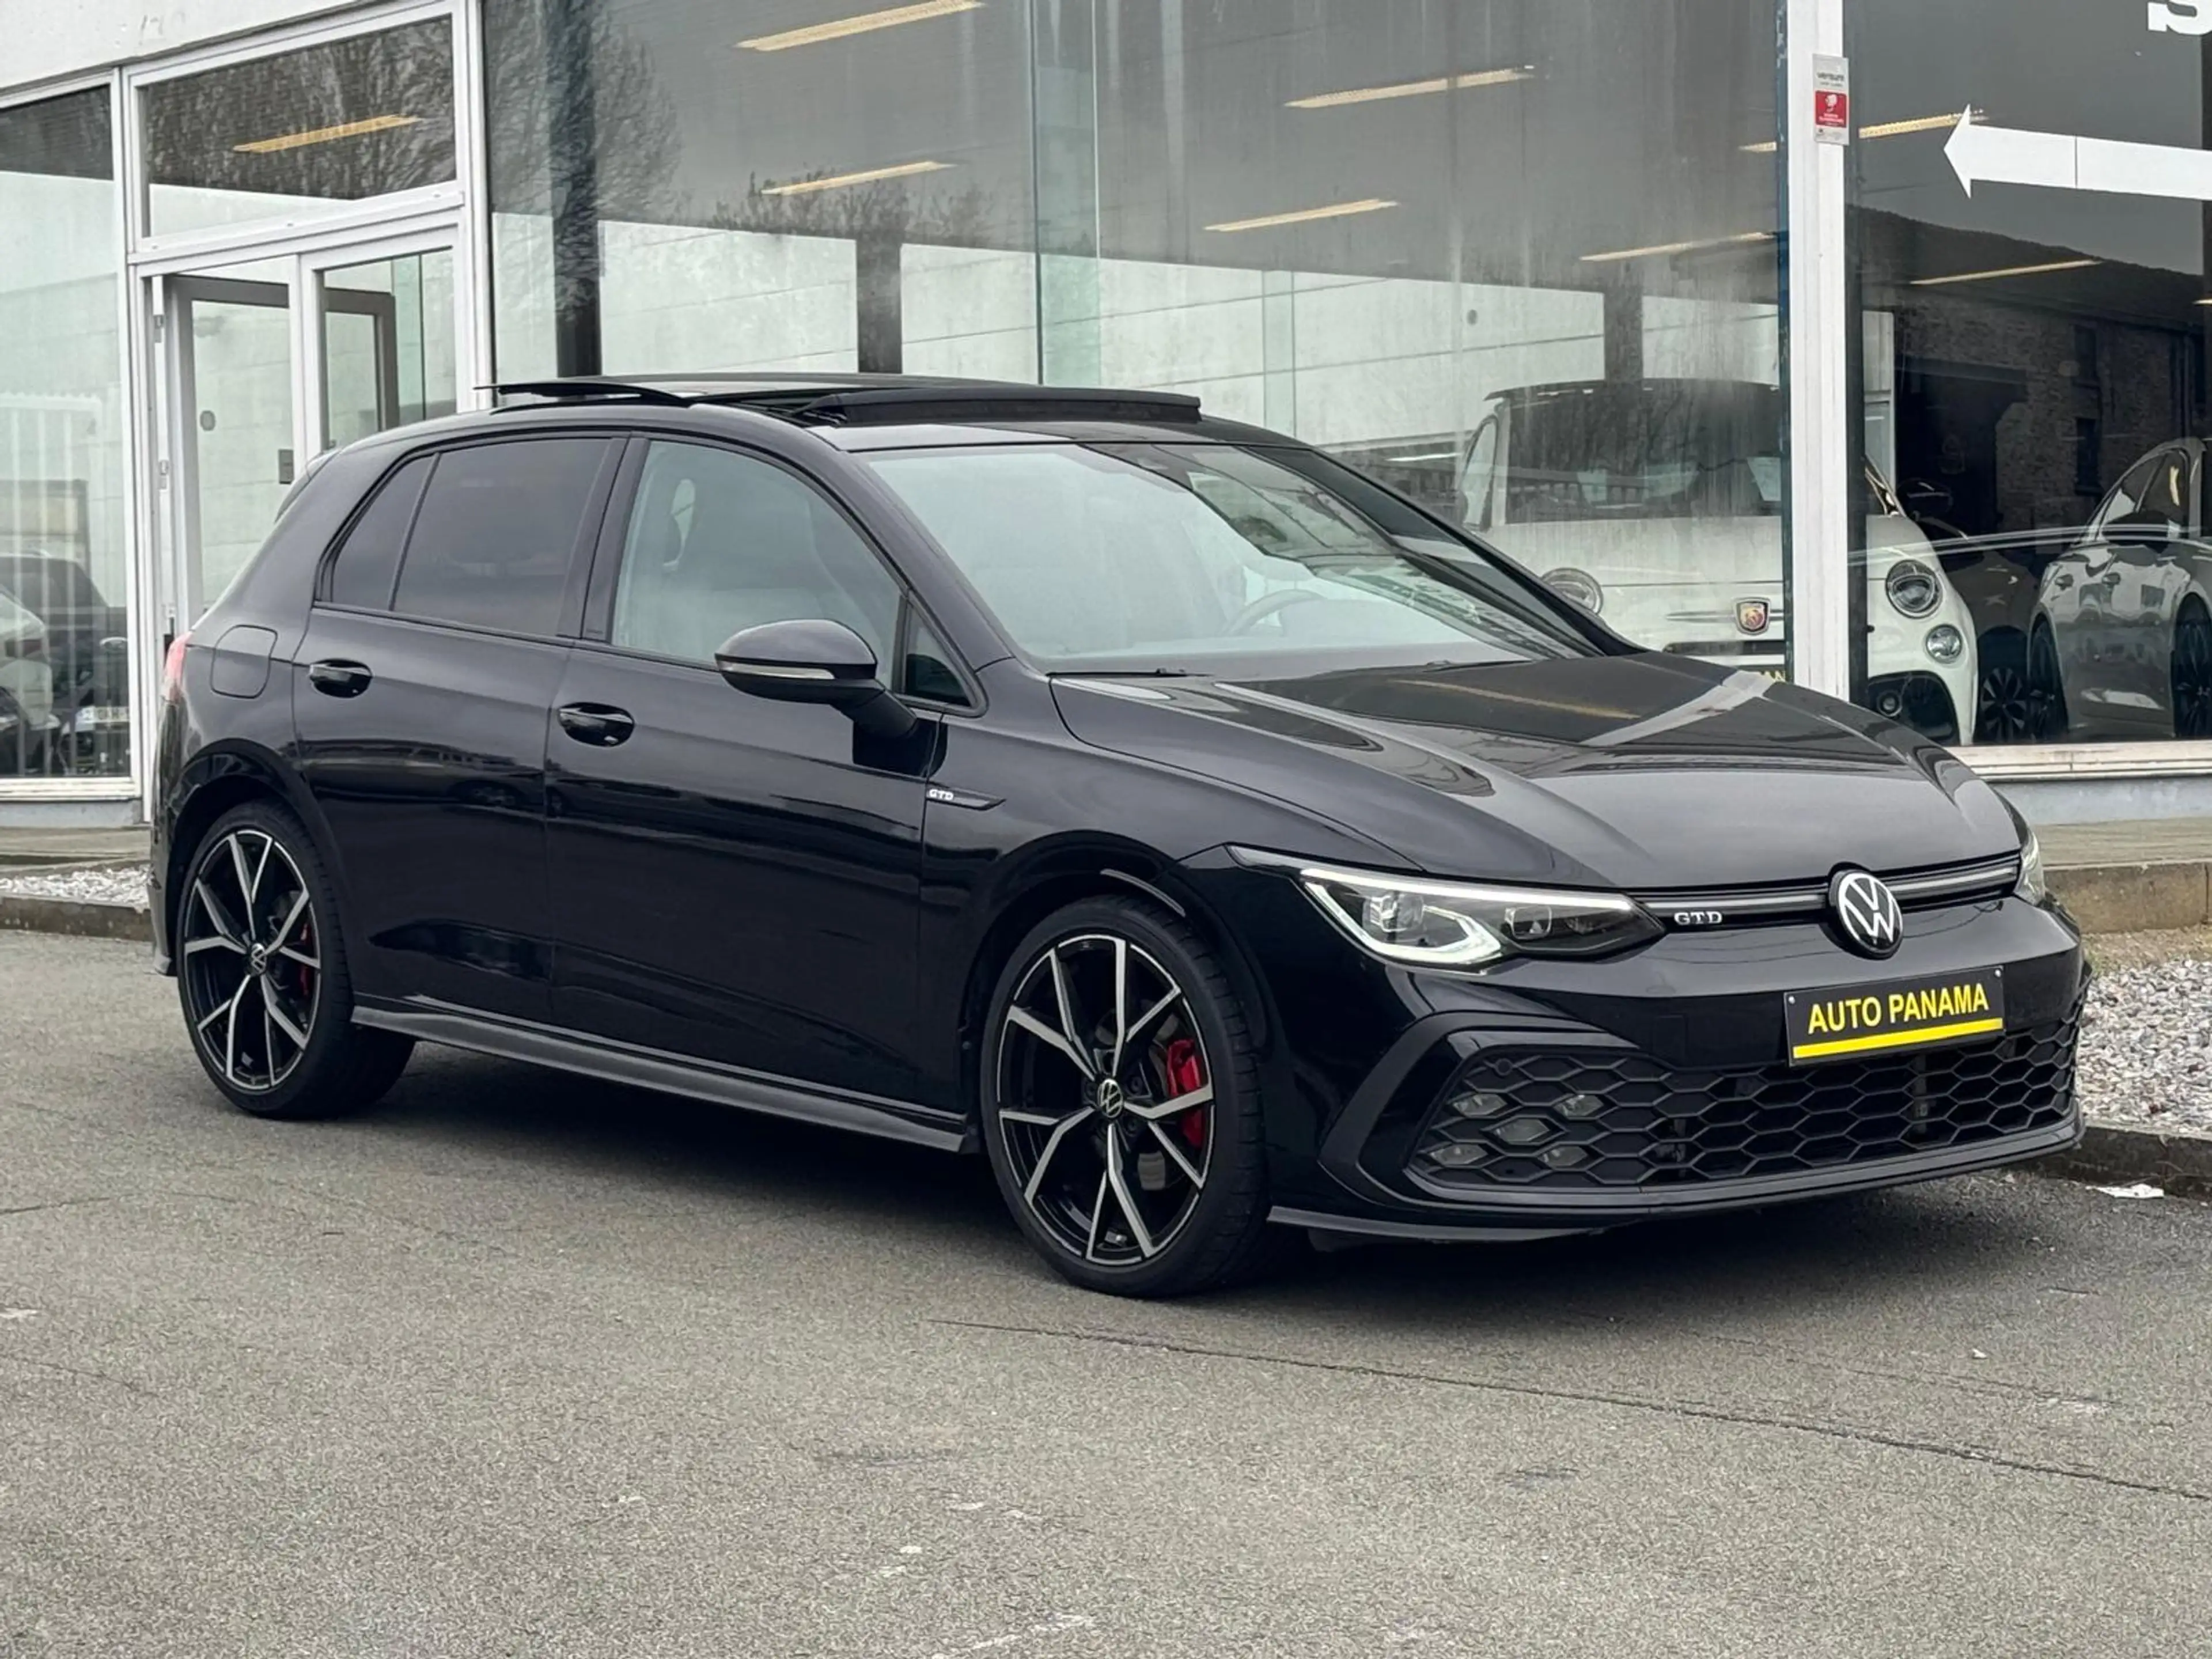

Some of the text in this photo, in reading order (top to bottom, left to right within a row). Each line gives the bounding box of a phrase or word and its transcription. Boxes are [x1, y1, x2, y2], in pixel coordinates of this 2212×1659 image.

[929, 789, 954, 801] GTD
[1673, 911, 1723, 925] GTD
[1808, 983, 1989, 1035] AUTO PANAMA
